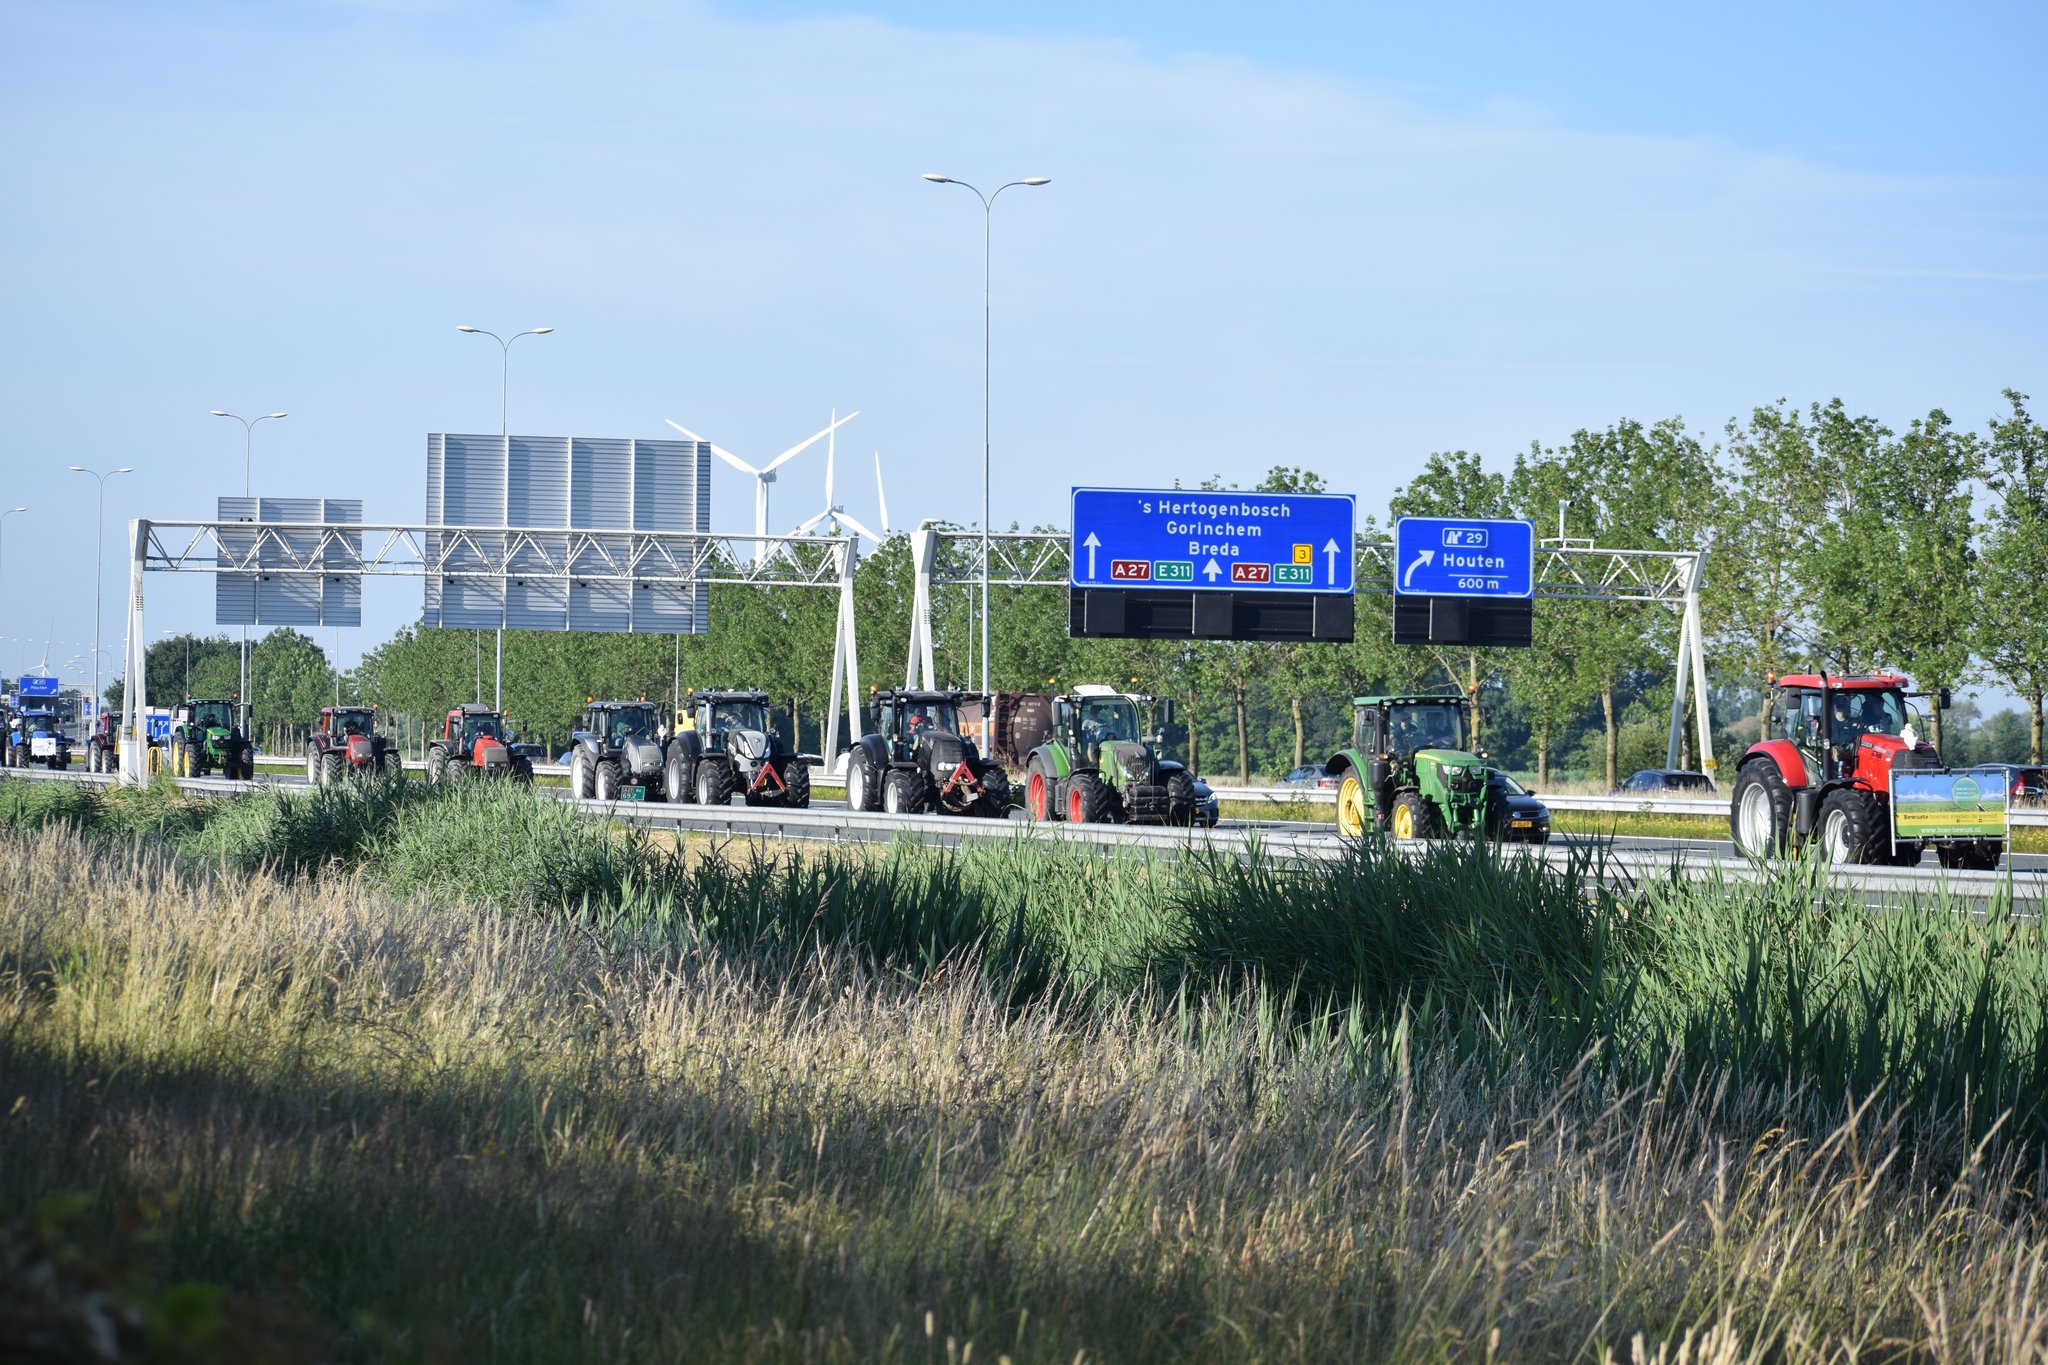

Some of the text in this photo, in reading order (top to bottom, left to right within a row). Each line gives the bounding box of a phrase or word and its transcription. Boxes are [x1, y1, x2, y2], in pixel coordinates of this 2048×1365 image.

[1159, 500, 1291, 519] Hertogenbosch
[1166, 521, 1262, 537] Gorinchem
[1466, 532, 1483, 544] 29
[1189, 541, 1240, 556] Breda
[1299, 549, 1307, 560] 3
[1443, 553, 1505, 569] Houten
[1458, 578, 1499, 590] 600 m
